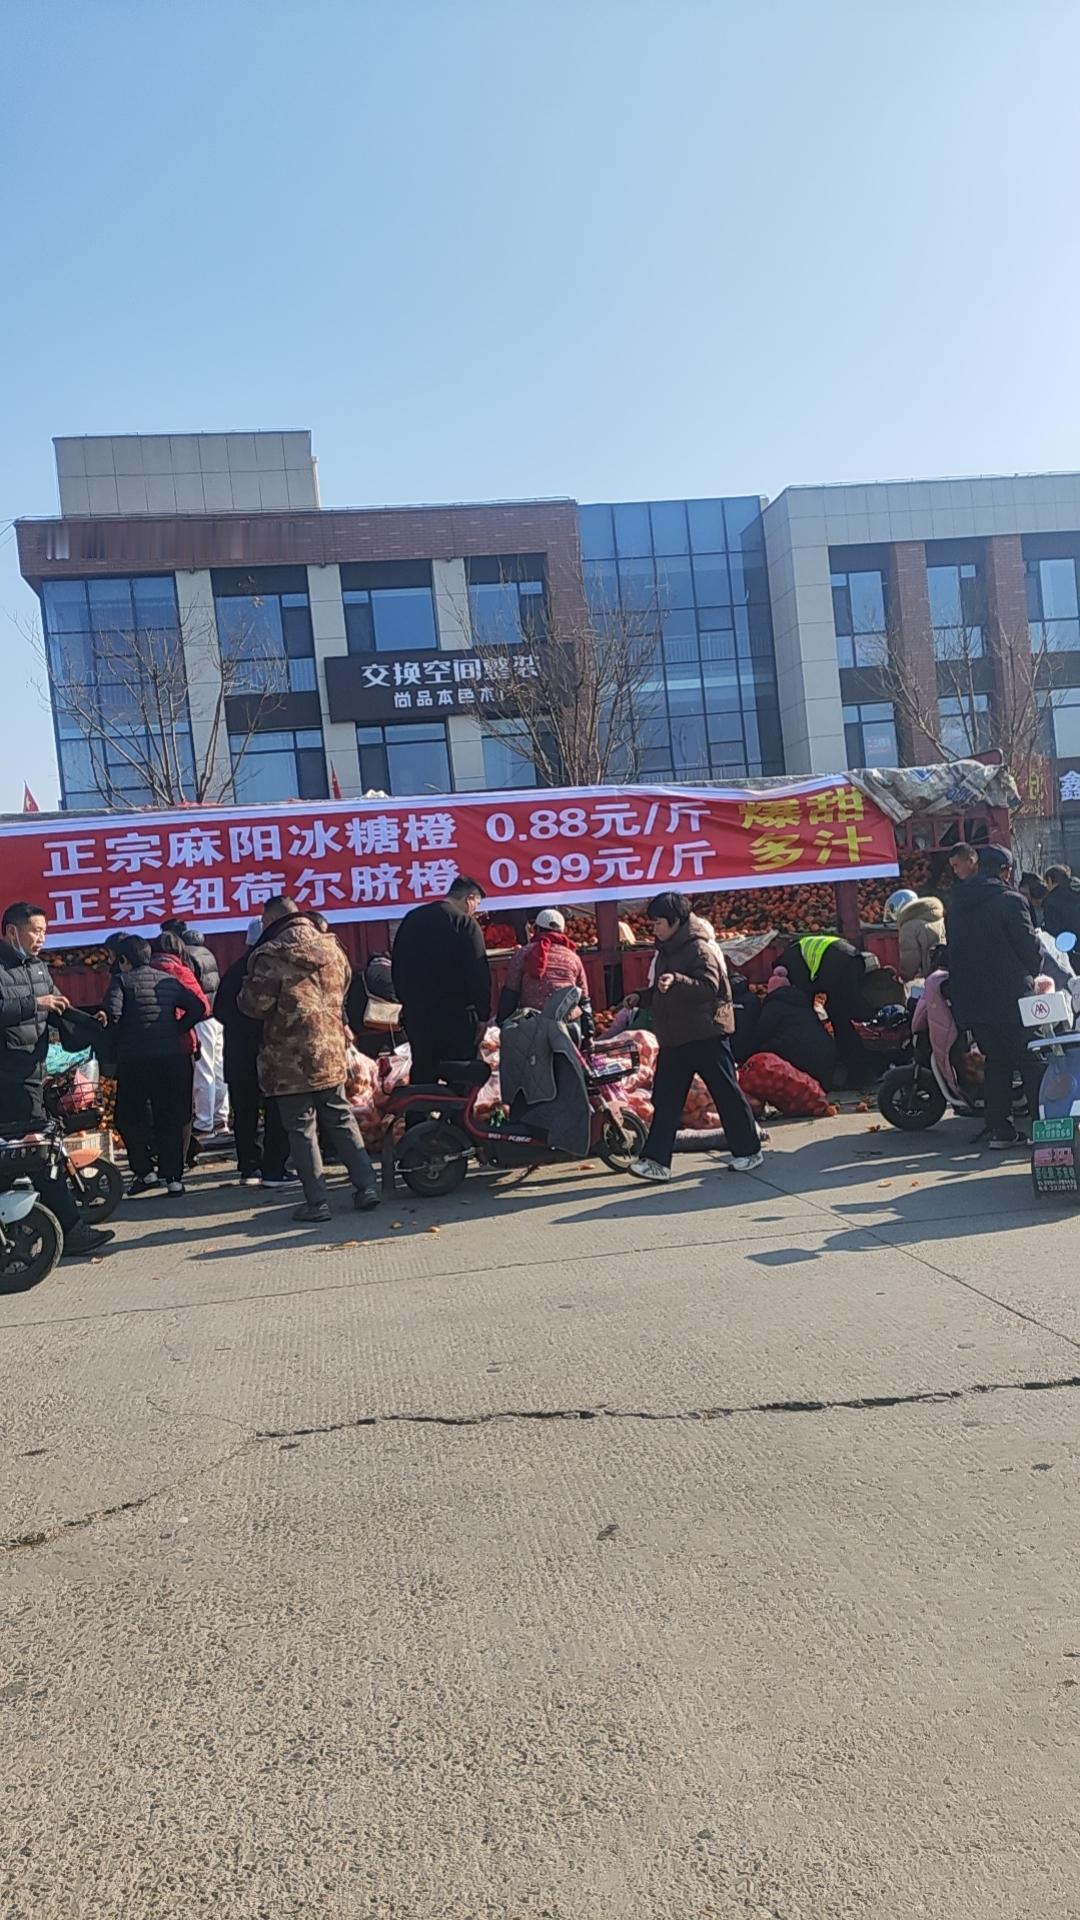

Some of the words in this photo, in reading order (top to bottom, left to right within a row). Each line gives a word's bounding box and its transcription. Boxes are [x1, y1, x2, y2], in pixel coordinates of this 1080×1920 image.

[361, 655, 540, 689] 交换空间整装
[393, 687, 506, 709] 尚品本色木
[738, 786, 865, 829] 爆甜
[42, 812, 458, 878] 正宗麻阳冰糖橙
[485, 800, 711, 843] 0.88元/斤
[748, 825, 873, 872] 多汁
[47, 858, 461, 927] 正宗纽荷尔脐橙
[488, 840, 717, 888] 0.99元/斤
